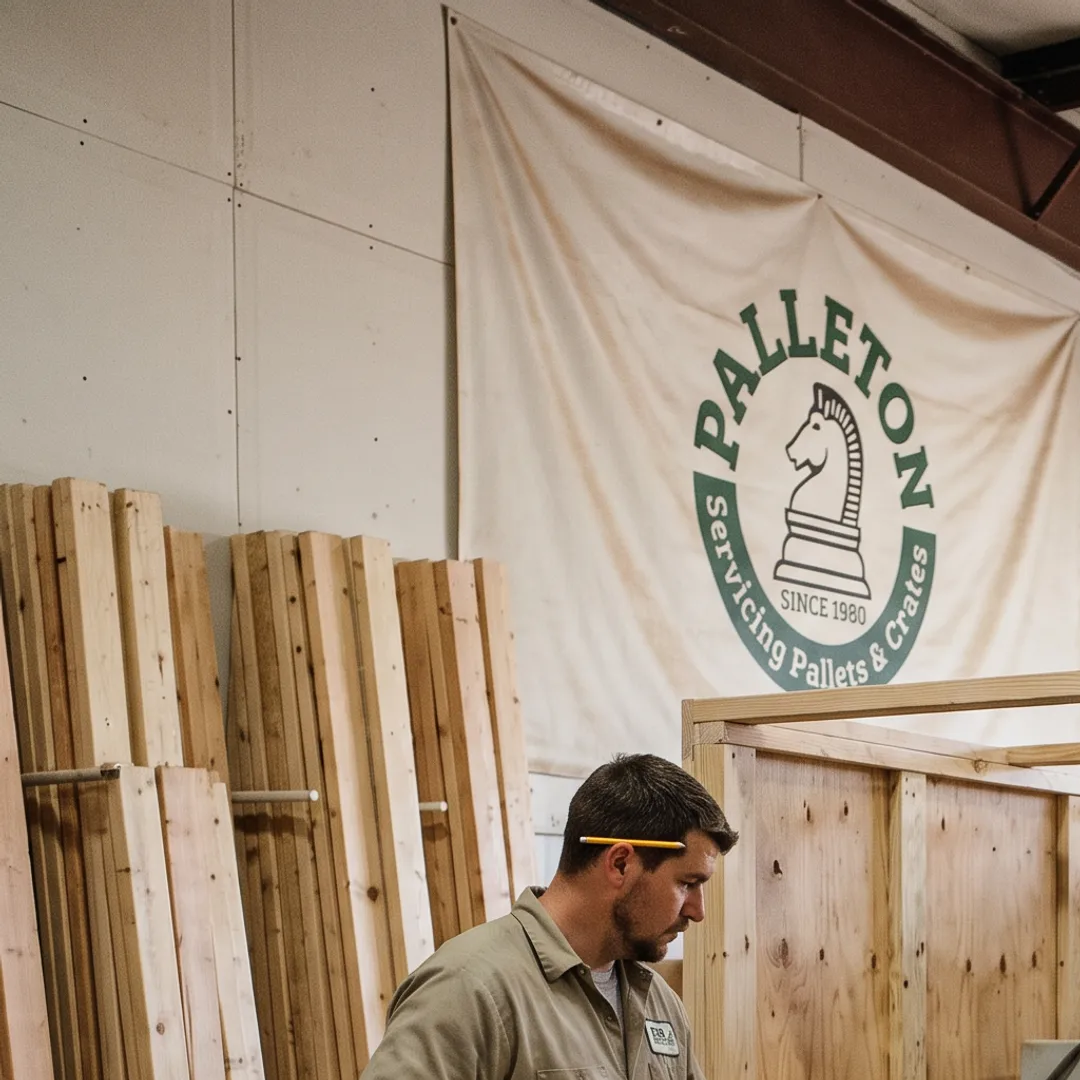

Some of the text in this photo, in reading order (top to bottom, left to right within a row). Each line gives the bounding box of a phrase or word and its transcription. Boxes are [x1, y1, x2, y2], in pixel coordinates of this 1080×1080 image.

[694, 288, 934, 509] PALLETON
[706, 495, 928, 688] Servicing Pallets & Crates
[781, 589, 866, 625] SINCE 1980
